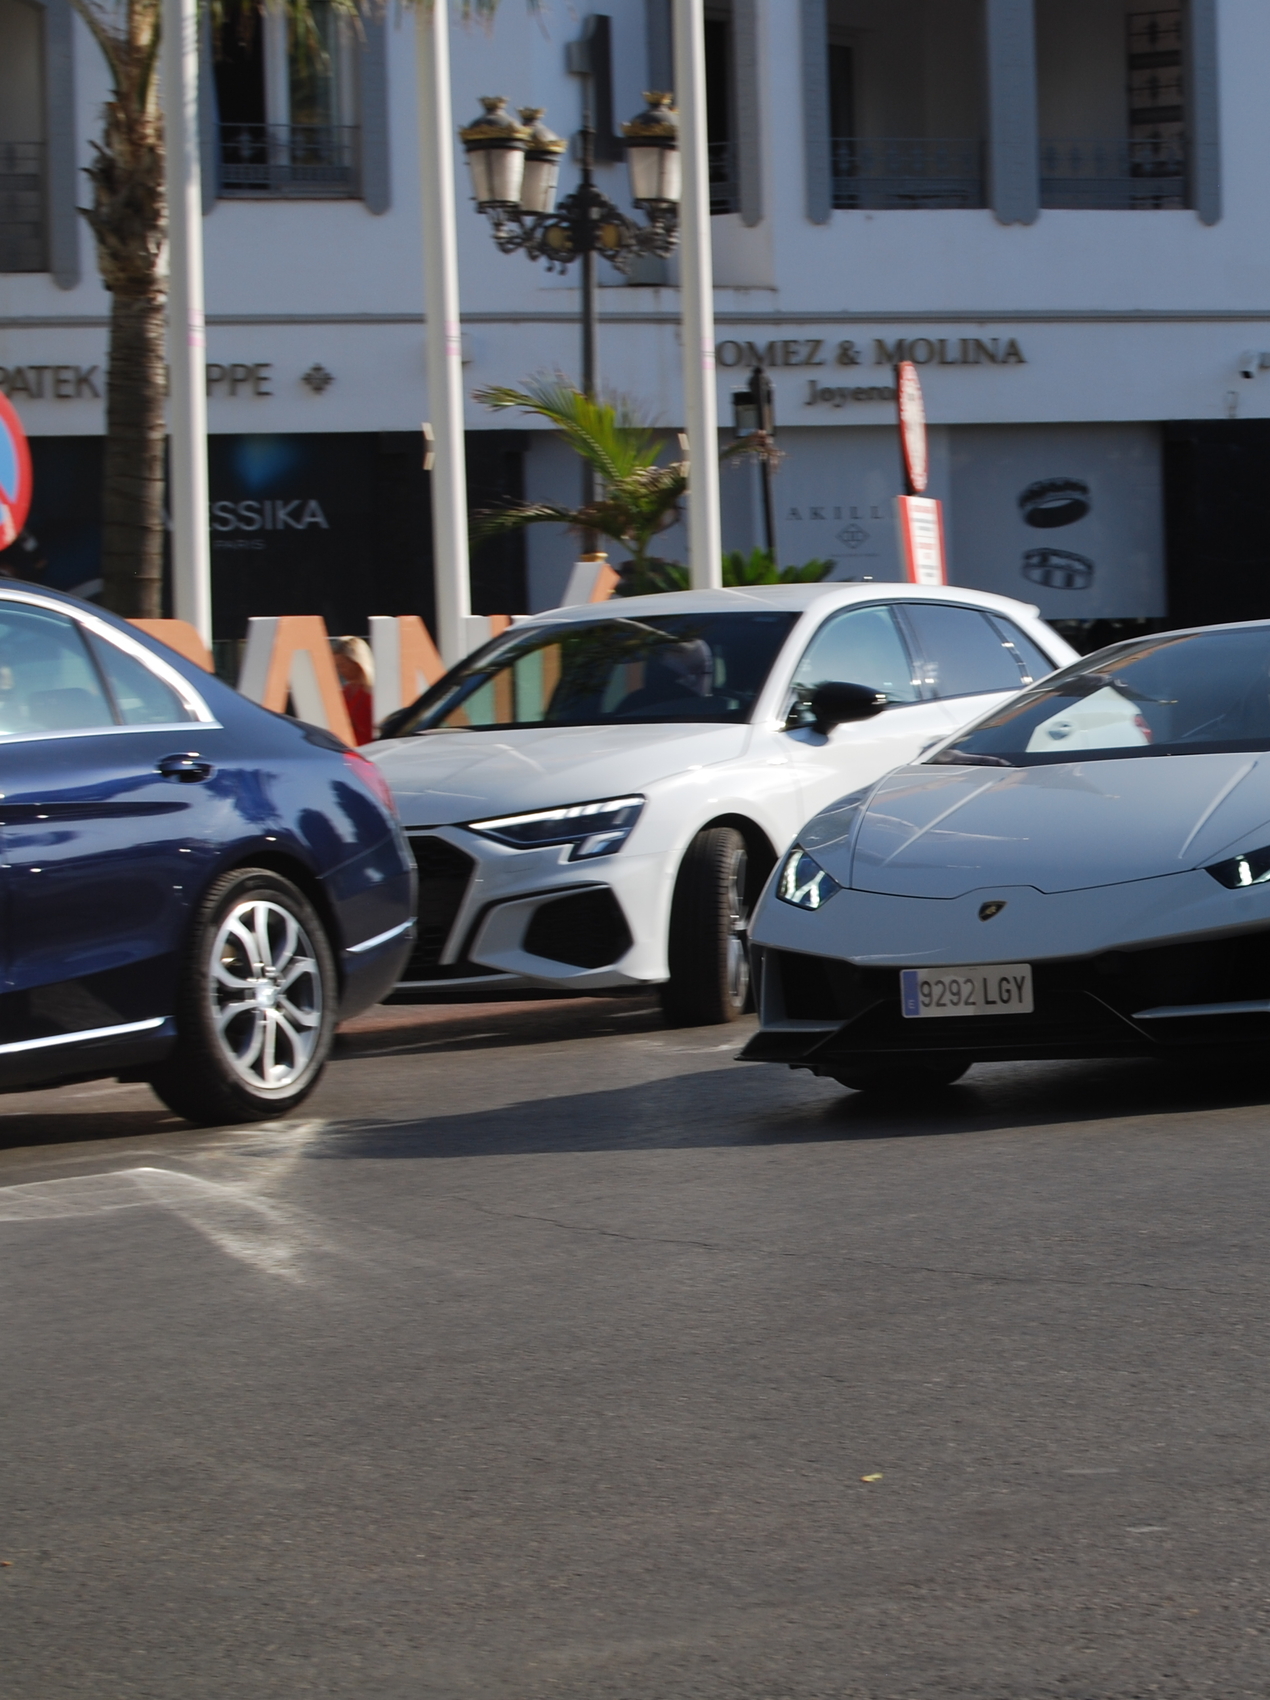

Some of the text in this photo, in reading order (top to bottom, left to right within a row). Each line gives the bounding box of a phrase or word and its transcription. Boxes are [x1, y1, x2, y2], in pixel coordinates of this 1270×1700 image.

[716, 337, 1026, 367] OMEZ & MOLINA
[805, 379, 897, 408] Joyero
[208, 500, 330, 531] SSIKA
[920, 975, 1026, 1008] 9292 LGY
